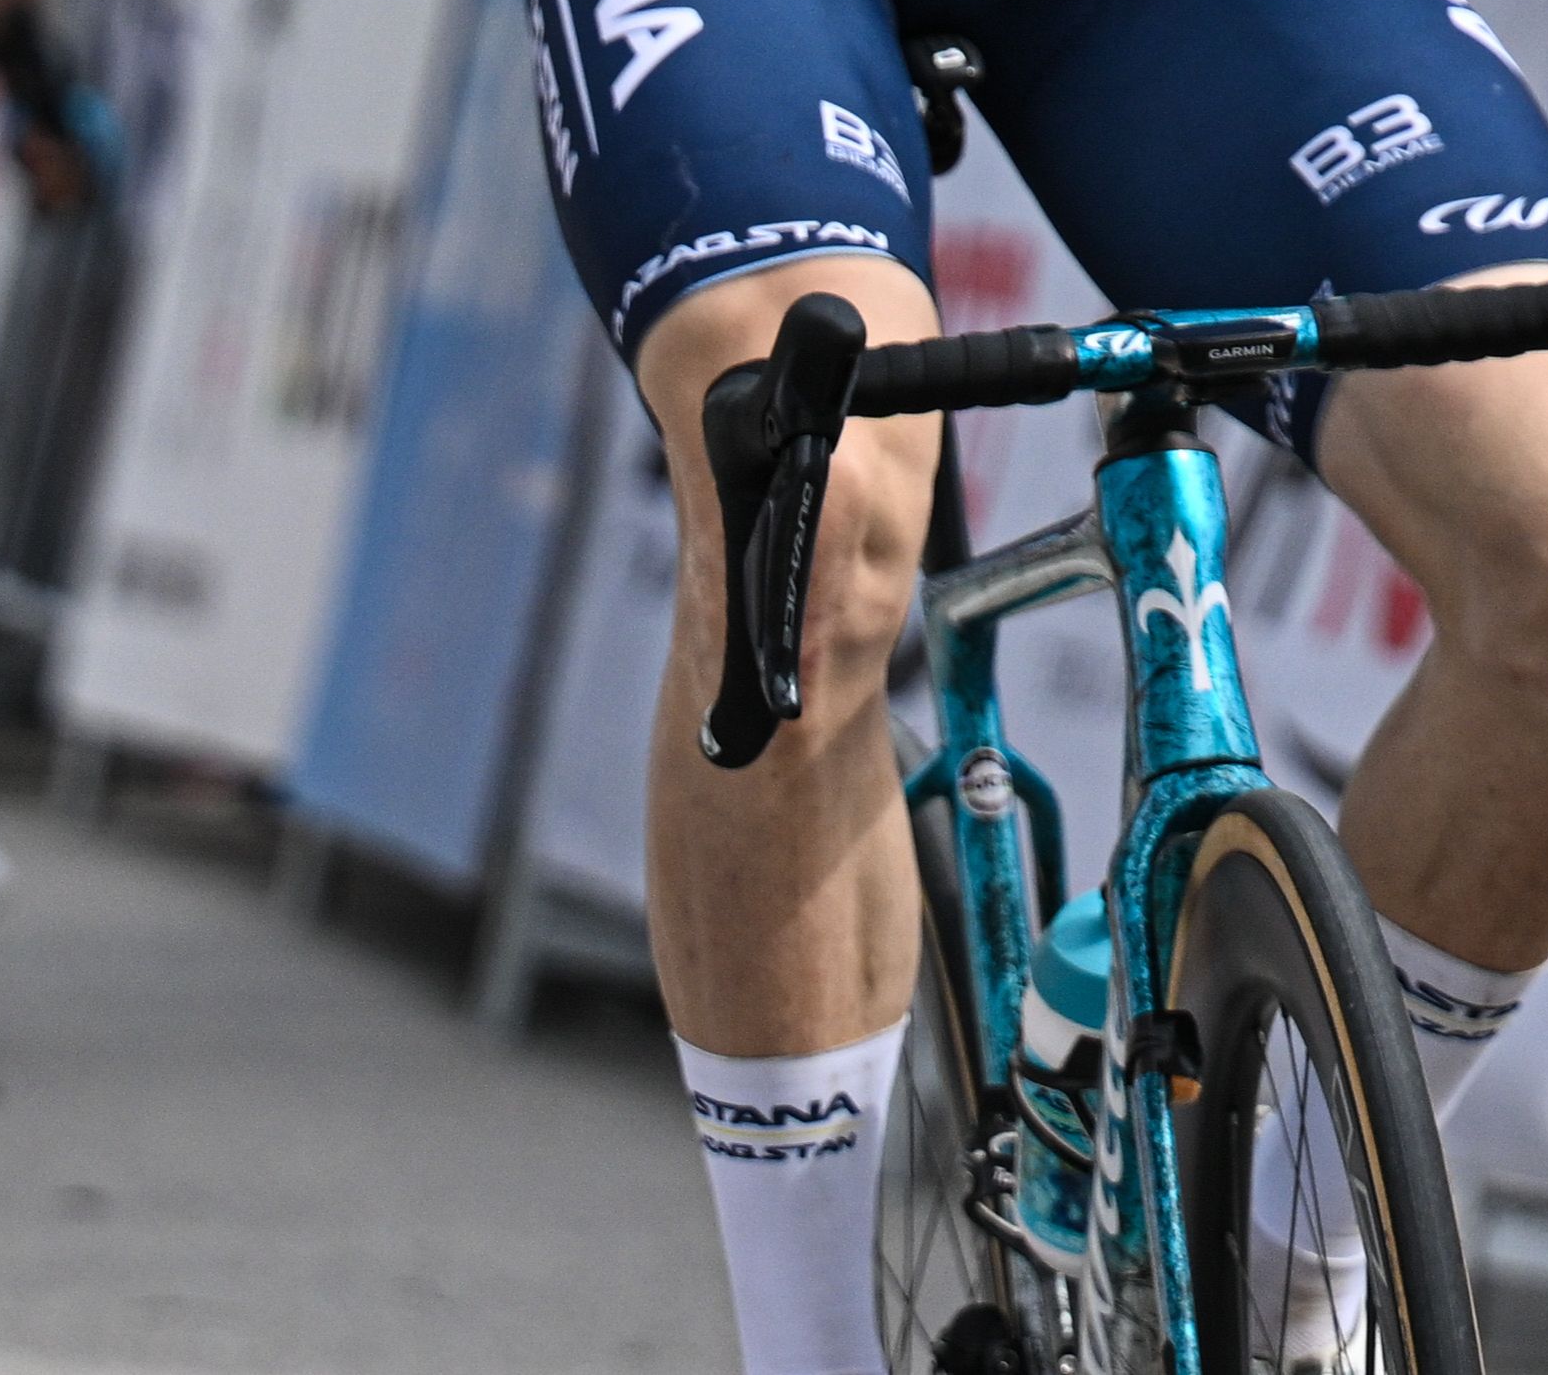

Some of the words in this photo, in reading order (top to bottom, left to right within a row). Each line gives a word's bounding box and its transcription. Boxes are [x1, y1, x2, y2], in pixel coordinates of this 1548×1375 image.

[1287, 93, 1433, 191] B3
[1317, 131, 1446, 205] BIEMME
[1208, 343, 1275, 360] GARMIN
[693, 1090, 861, 1127] STANA
